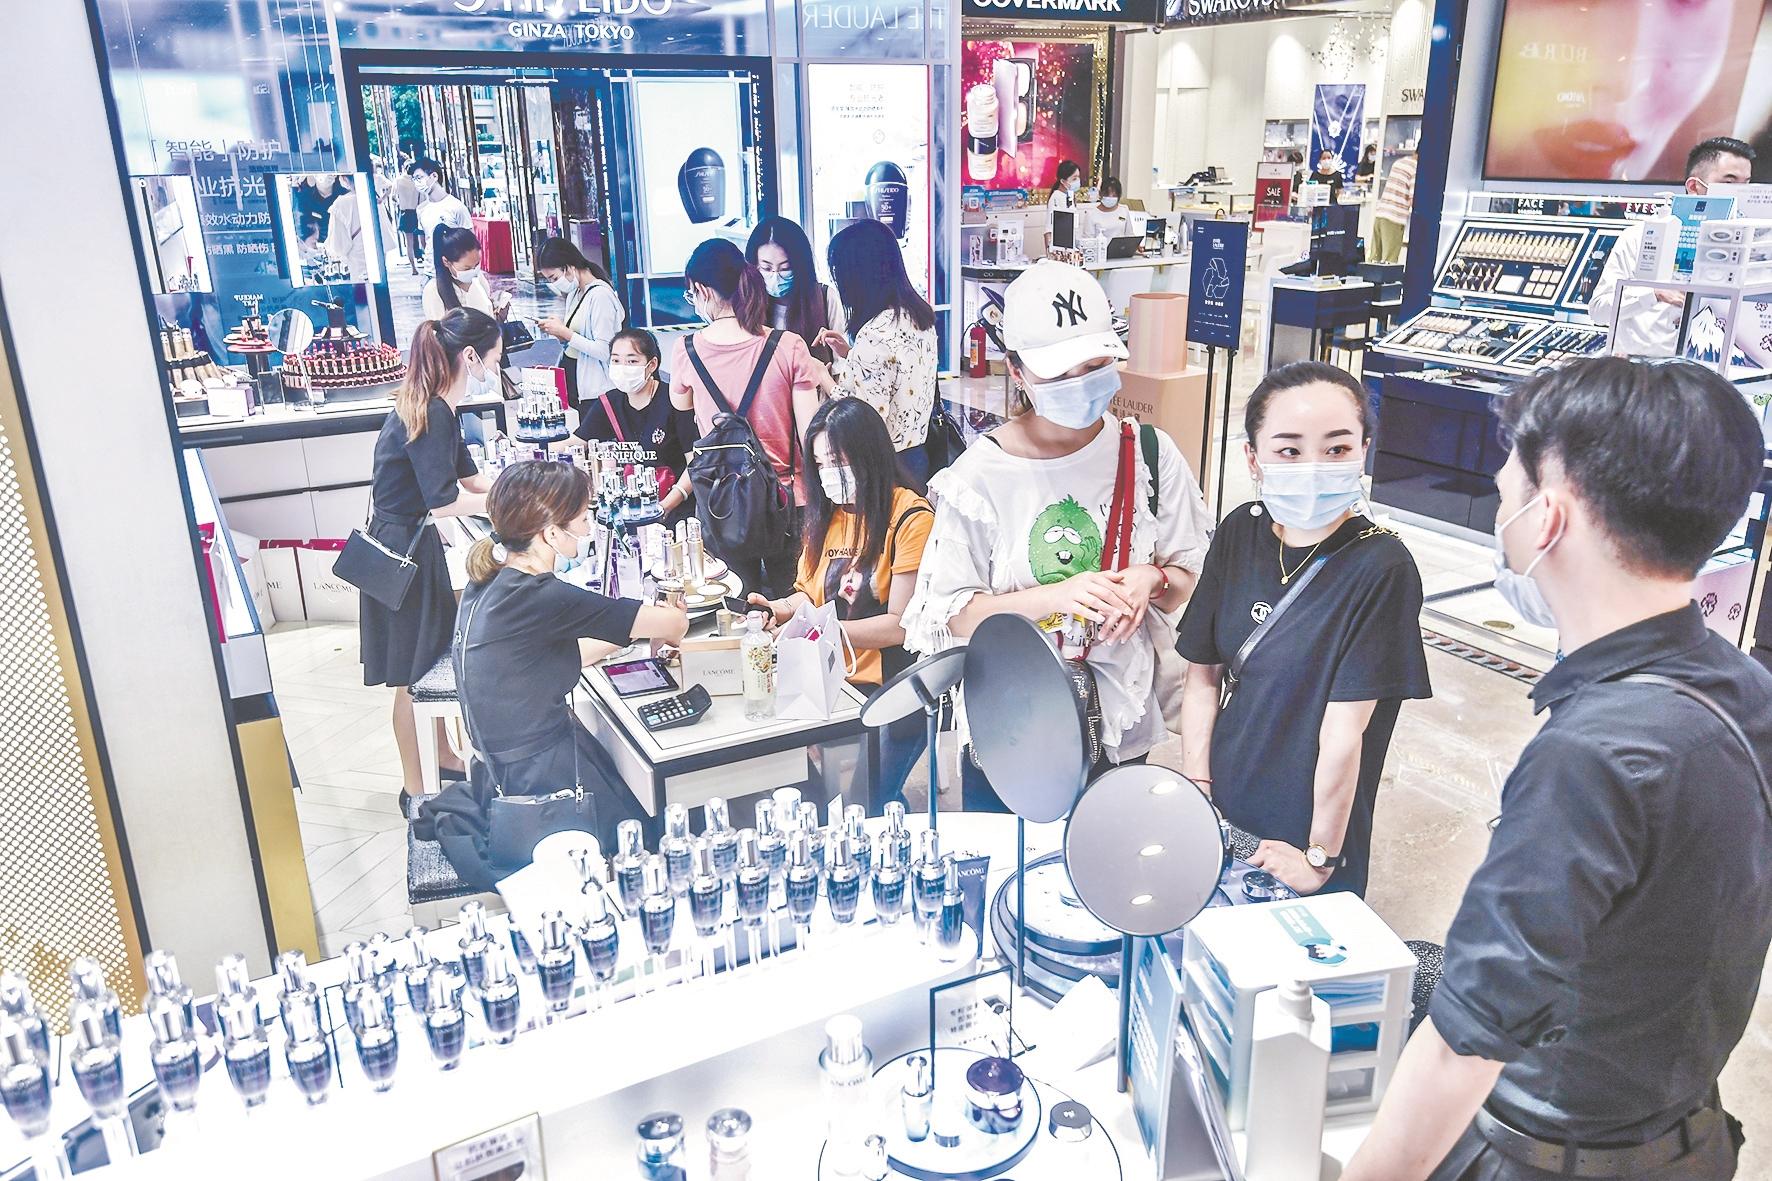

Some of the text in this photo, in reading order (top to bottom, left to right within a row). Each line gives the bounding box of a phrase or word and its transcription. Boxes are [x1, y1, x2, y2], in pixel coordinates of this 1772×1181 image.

[508, 21, 566, 39] GINZA
[574, 23, 635, 41] TOKYO
[1266, 187, 1281, 197] SALE
[1517, 198, 1545, 209] FACE
[1625, 202, 1657, 214] EYES
[1123, 398, 1154, 414] LAUDER
[613, 441, 639, 451] NEW
